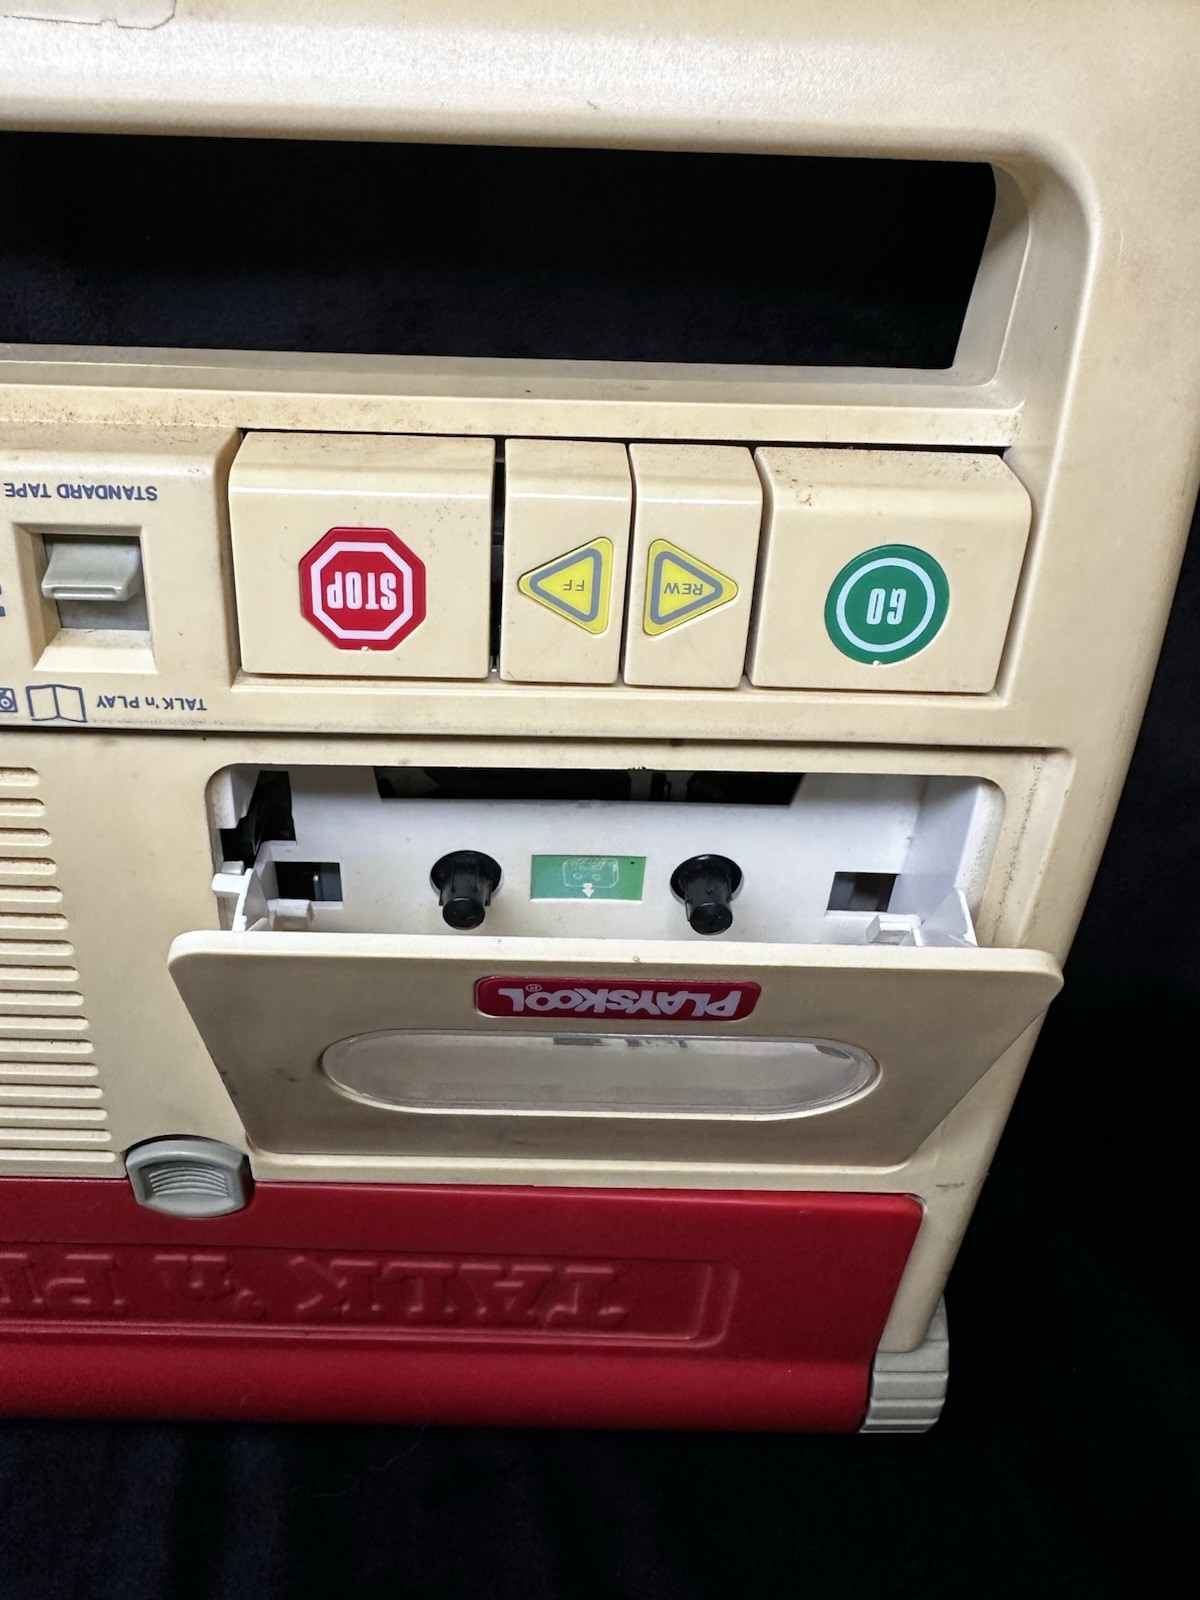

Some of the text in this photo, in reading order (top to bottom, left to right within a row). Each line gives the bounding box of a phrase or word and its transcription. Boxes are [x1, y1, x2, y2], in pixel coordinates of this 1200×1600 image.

[3, 482, 158, 502] STANDARD TAPE
[326, 571, 397, 611] STOP
[562, 579, 585, 592] FF
[663, 582, 704, 596] REW
[865, 587, 907, 626] GO
[96, 695, 140, 709] PLAY
[162, 697, 207, 711] TALK
[289, 1256, 627, 1329] TALK
